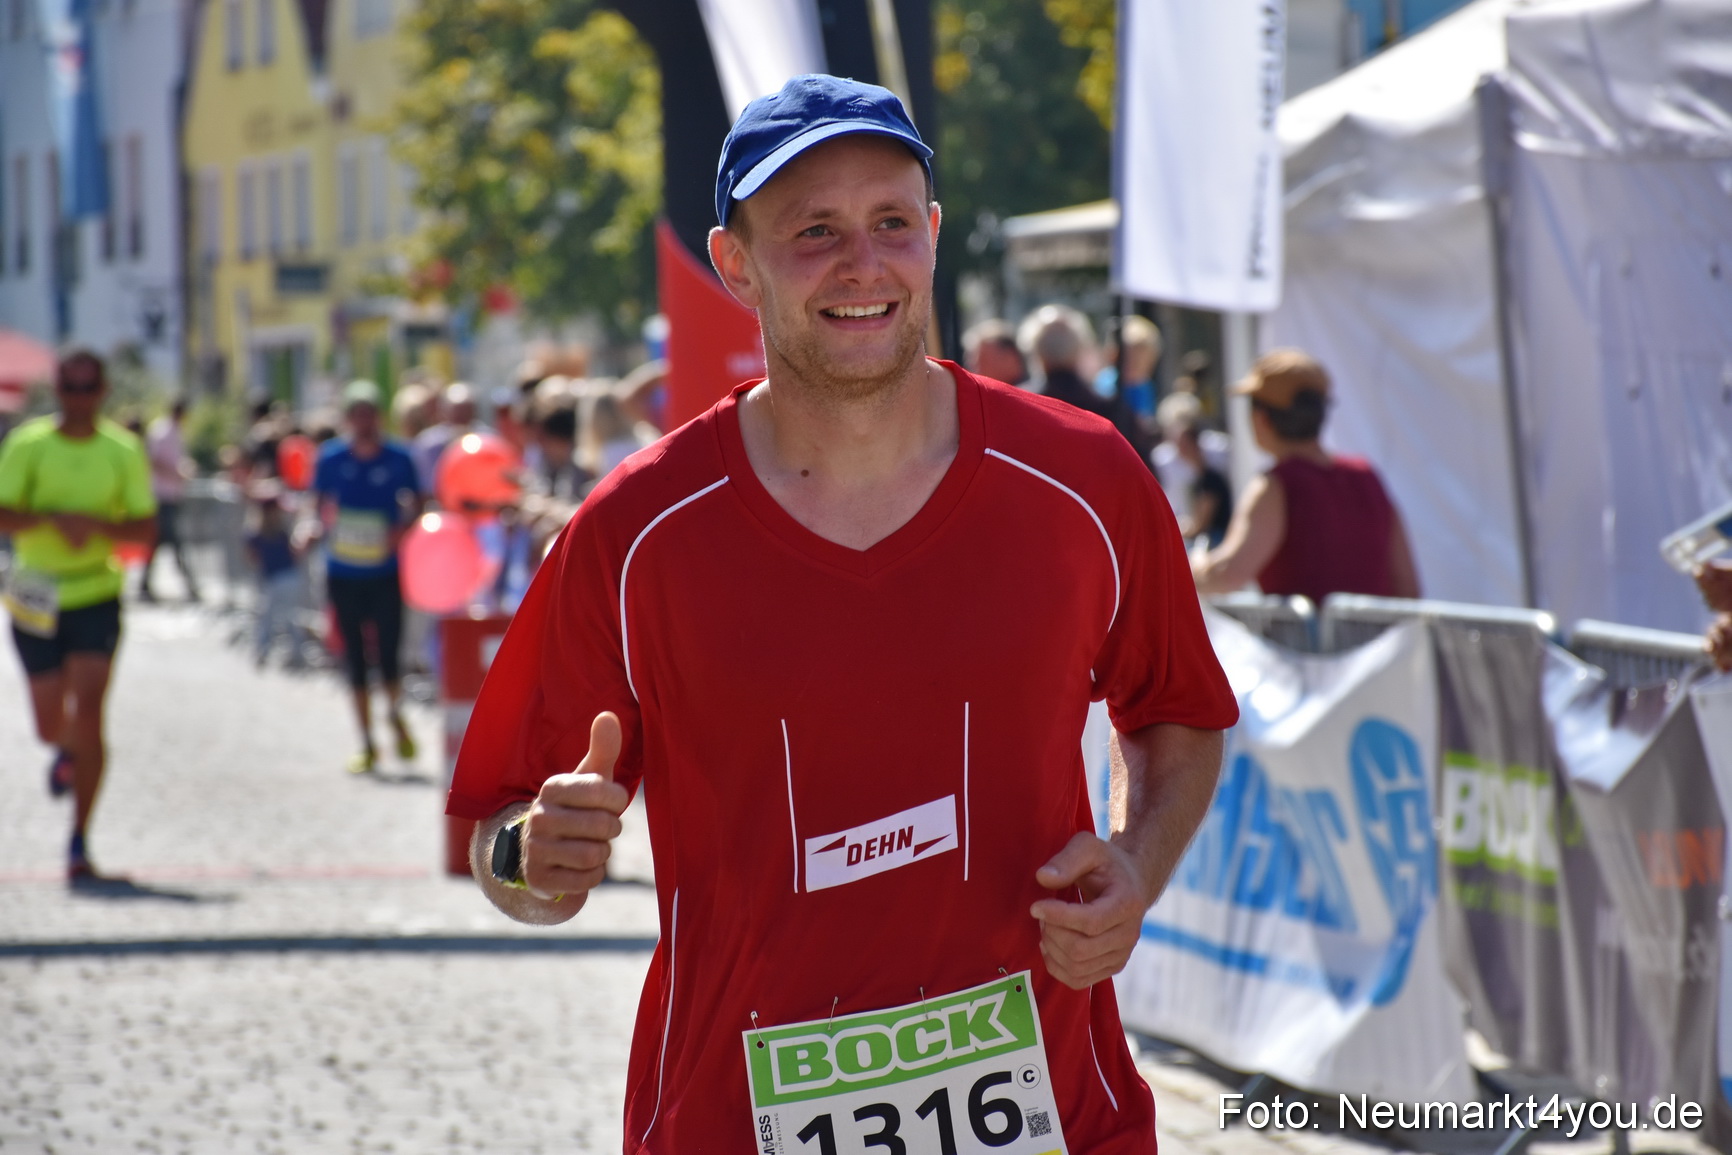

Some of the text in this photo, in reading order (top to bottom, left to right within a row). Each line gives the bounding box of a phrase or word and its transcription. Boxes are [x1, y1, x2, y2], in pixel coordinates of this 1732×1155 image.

[846, 825, 914, 867] DEHN
[771, 991, 1015, 1093] BOCK
[1022, 1069, 1036, 1083] C
[796, 1070, 1024, 1155] 1316
